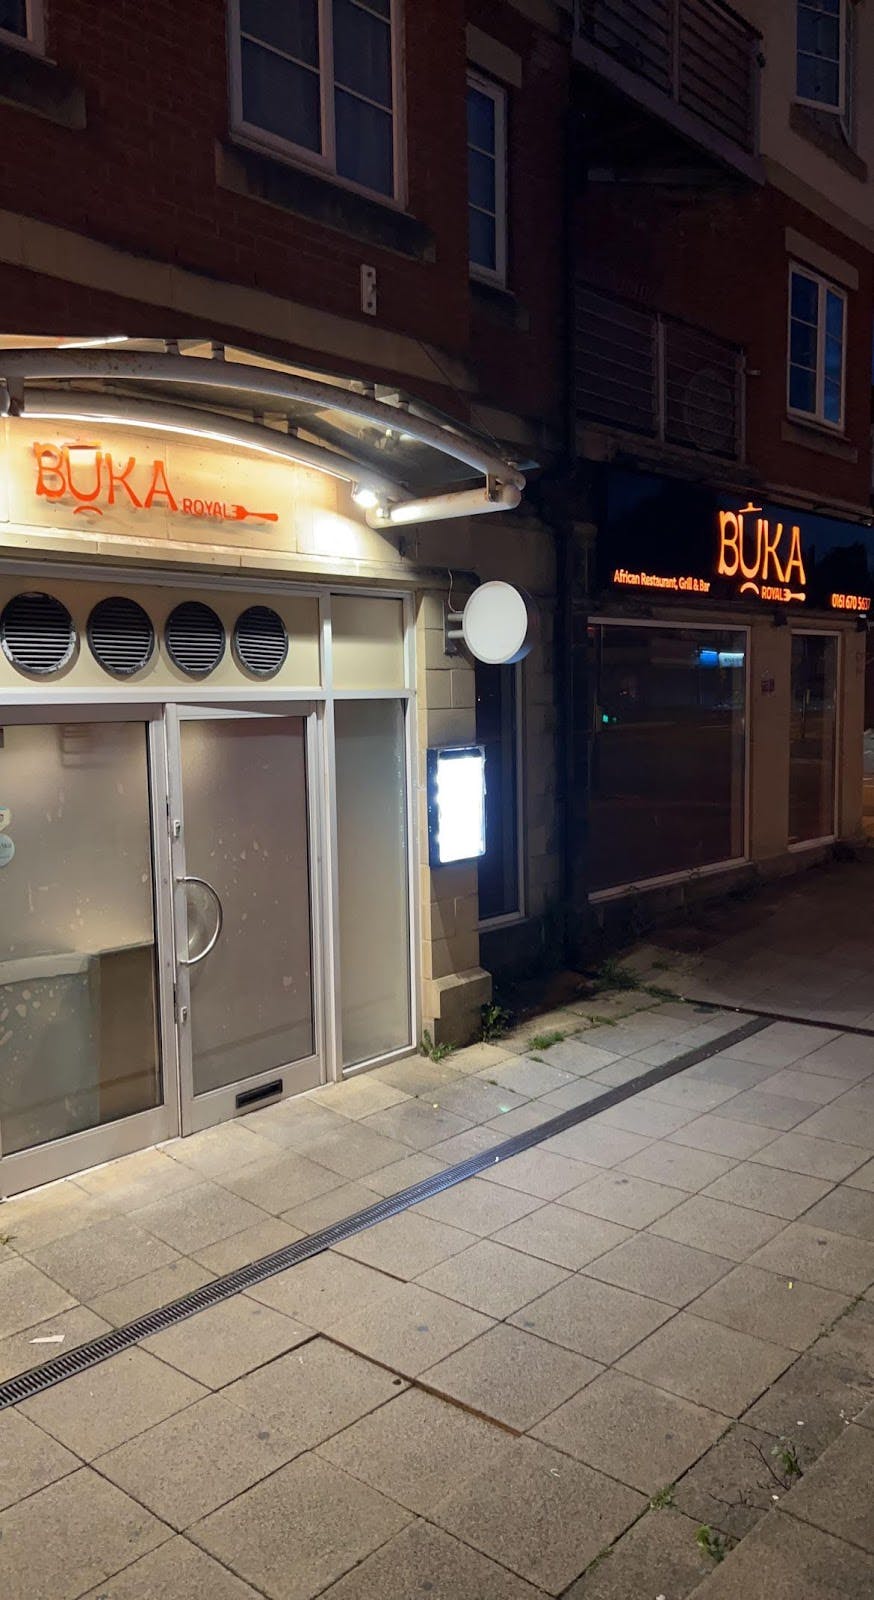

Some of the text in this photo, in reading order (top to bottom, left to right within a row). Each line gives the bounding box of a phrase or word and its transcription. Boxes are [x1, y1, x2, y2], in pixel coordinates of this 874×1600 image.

[32, 441, 178, 511] BUKA
[182, 498, 230, 520] ROYAL
[718, 510, 806, 585] BUKA
[613, 569, 711, 592] African Restaurant, Grill & Bar
[761, 585, 784, 601] ROYAL
[832, 593, 846, 609] 0161
[846, 595, 857, 610] 670
